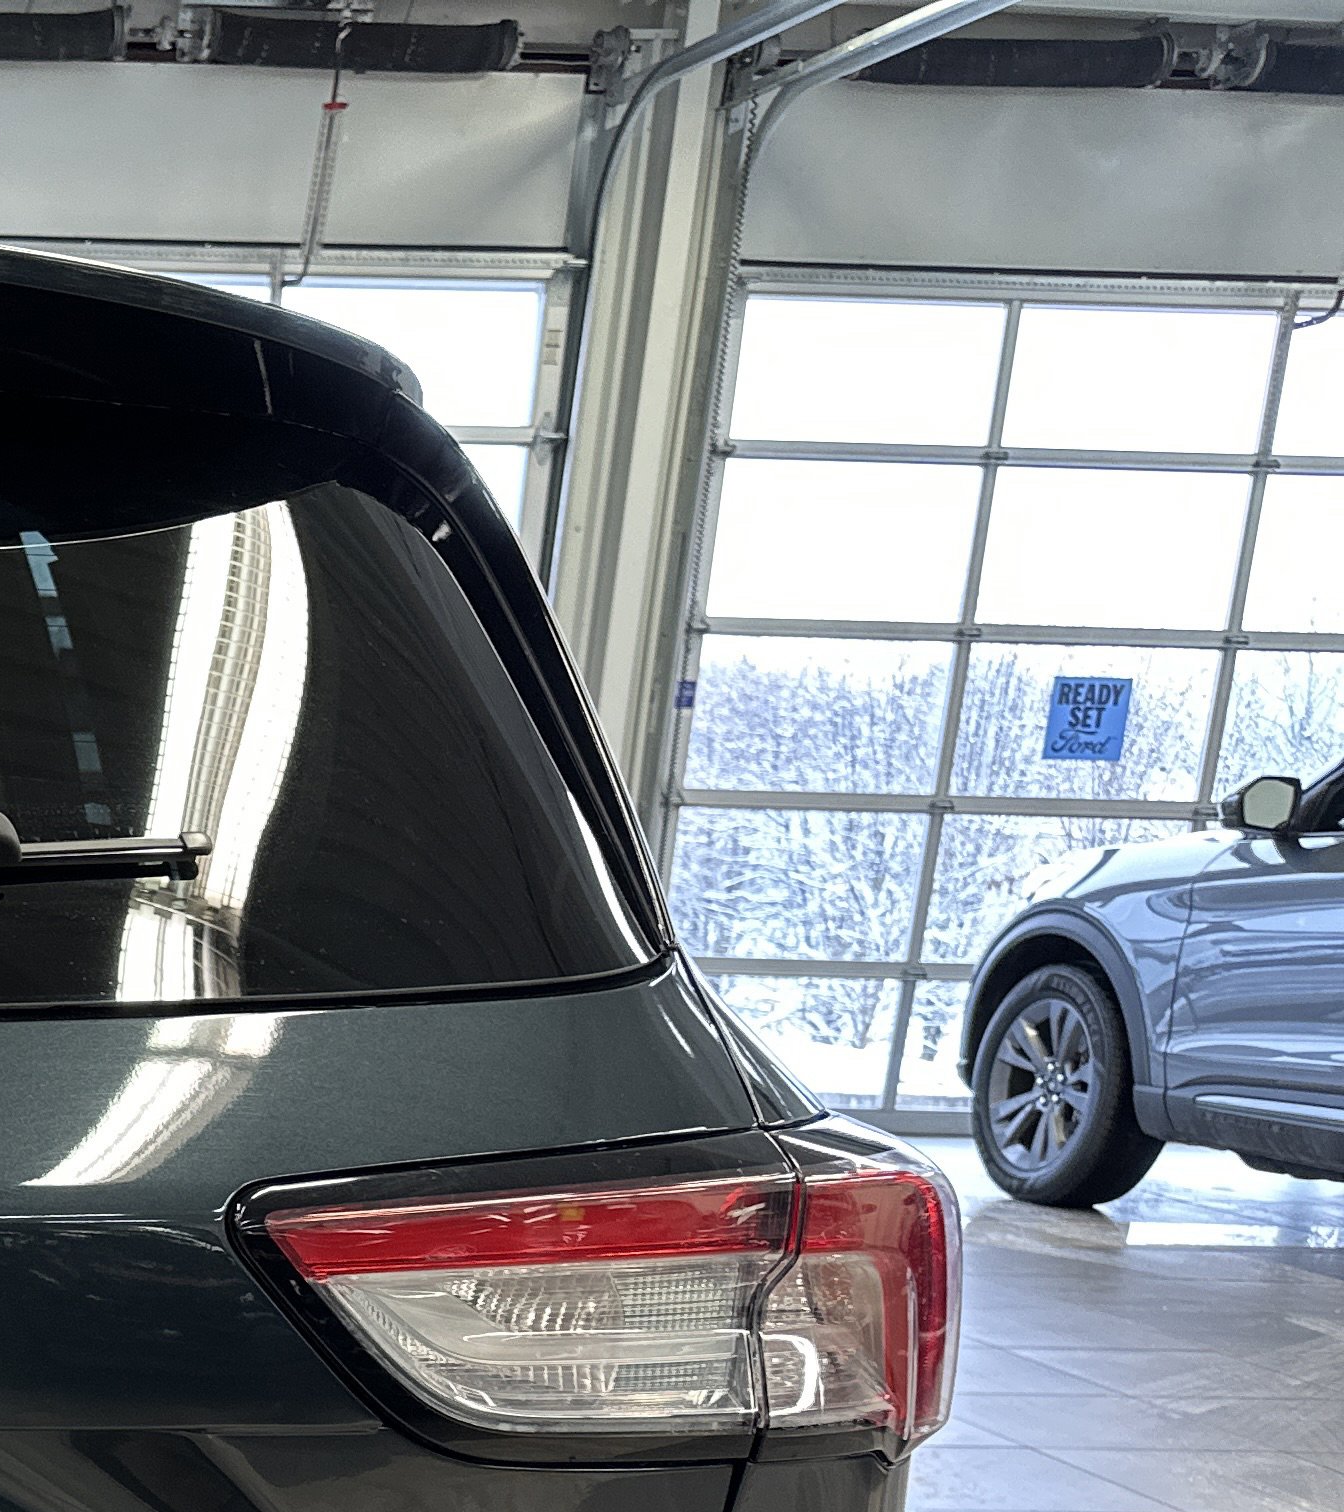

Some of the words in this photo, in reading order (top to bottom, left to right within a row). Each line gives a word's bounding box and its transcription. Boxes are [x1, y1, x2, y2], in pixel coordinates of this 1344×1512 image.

[1057, 683, 1125, 706] READY
[1068, 706, 1106, 729] SET
[1051, 729, 1118, 755] Ford
